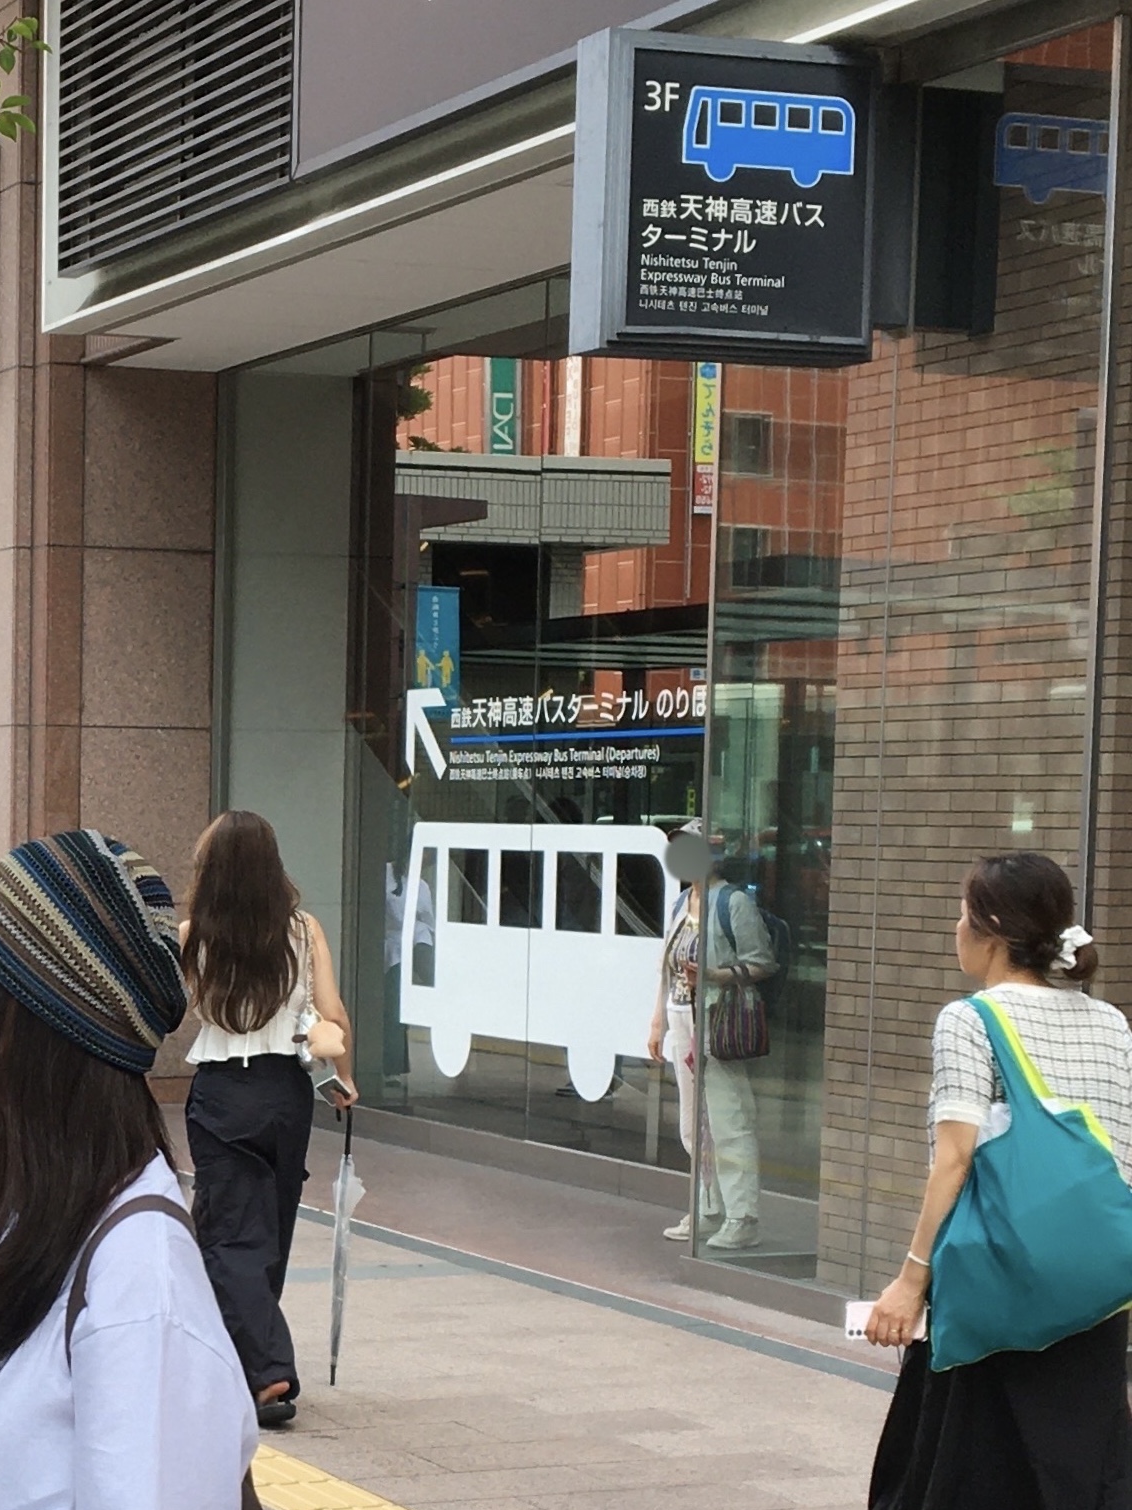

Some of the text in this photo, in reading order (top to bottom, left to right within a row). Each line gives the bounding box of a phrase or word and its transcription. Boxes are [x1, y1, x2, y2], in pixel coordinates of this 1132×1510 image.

[643, 81, 681, 112] 3F
[641, 193, 826, 229] 西鉄天神高速バス
[641, 223, 757, 255] ターミナル
[640, 254, 739, 274] Nishitetsu Tenjin
[640, 268, 786, 288] Expressway Bus Terminal
[450, 690, 650, 730] 西鉄天神高速バスターミナル
[449, 744, 661, 766] Nishitetsu Tenjin Expressway Bus Terminal (Departures)
